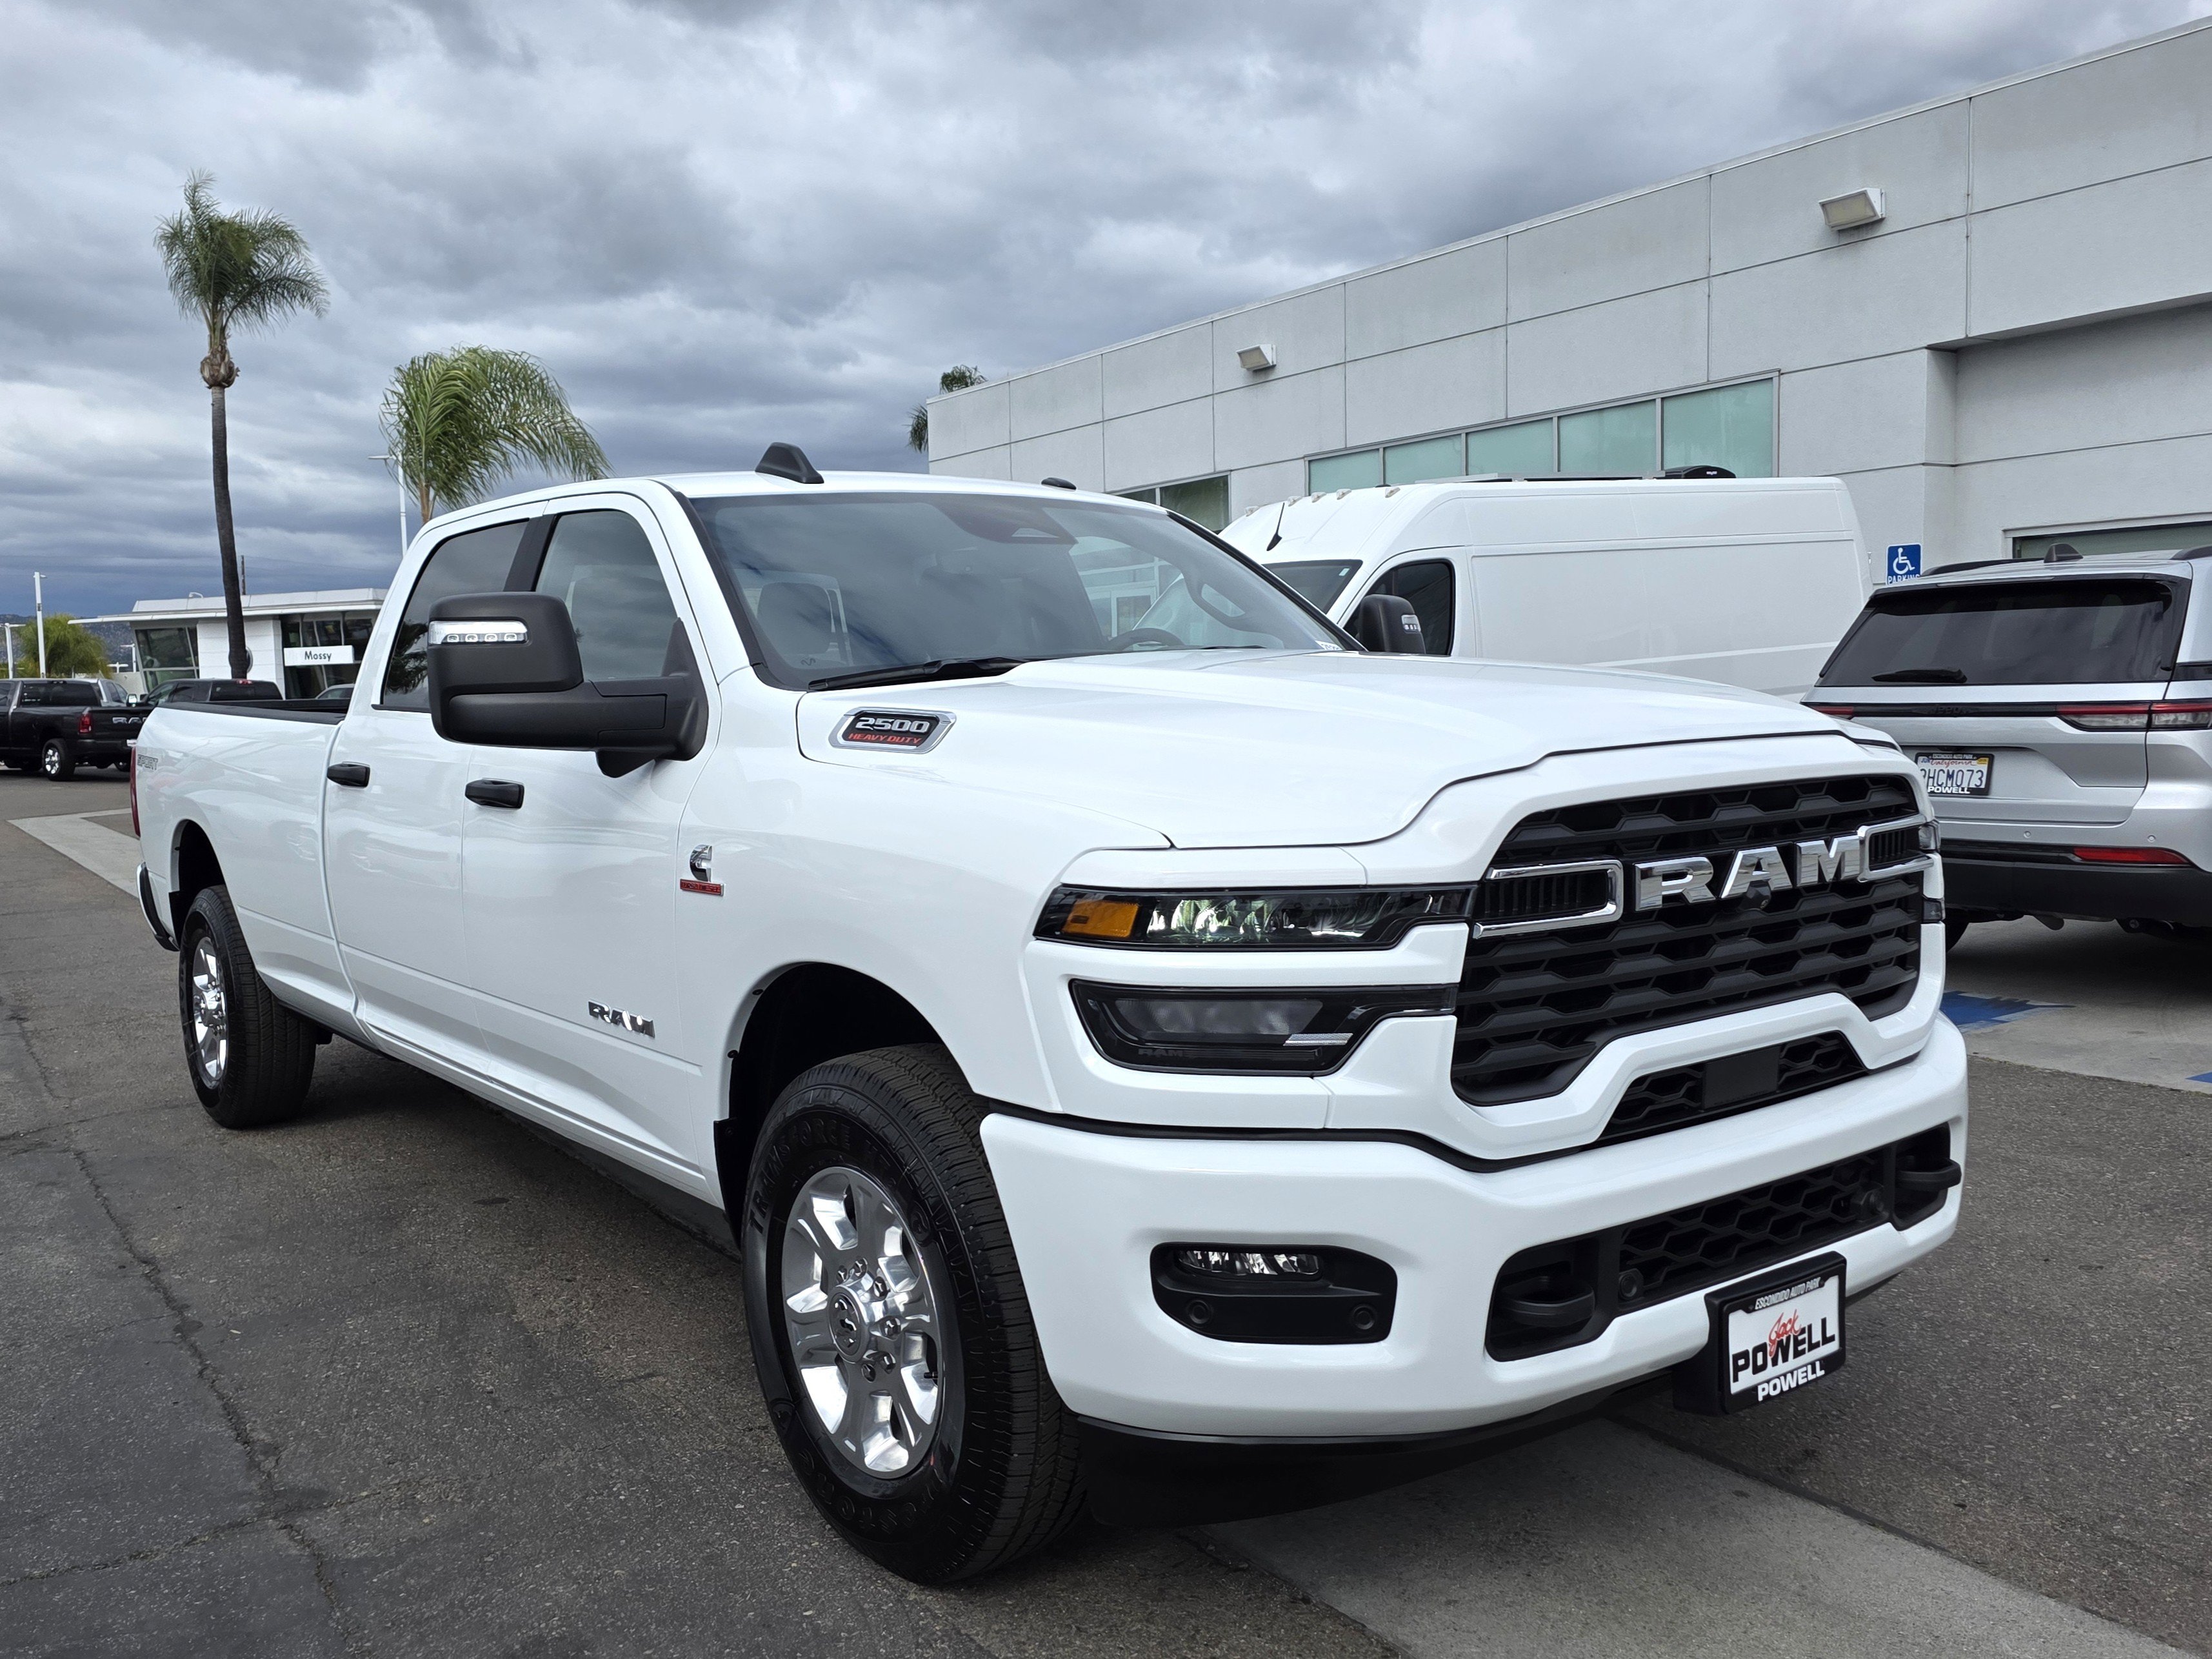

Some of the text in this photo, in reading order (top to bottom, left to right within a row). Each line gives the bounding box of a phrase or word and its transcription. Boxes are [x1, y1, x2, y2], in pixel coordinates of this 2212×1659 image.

[304, 650, 332, 662] Mossy
[855, 717, 930, 734] 2500
[848, 733, 922, 744] HEAVY DUTY
[1930, 759, 1974, 769] California
[1634, 836, 1860, 912] RAM
[588, 1000, 655, 1038] RAM
[1137, 1048, 1183, 1057] RAM
[1806, 1277, 1821, 1292] PARK
[1768, 1309, 1802, 1358] Jack
[1732, 1317, 1835, 1383] POWELL
[1758, 1361, 1825, 1402] POWELL
